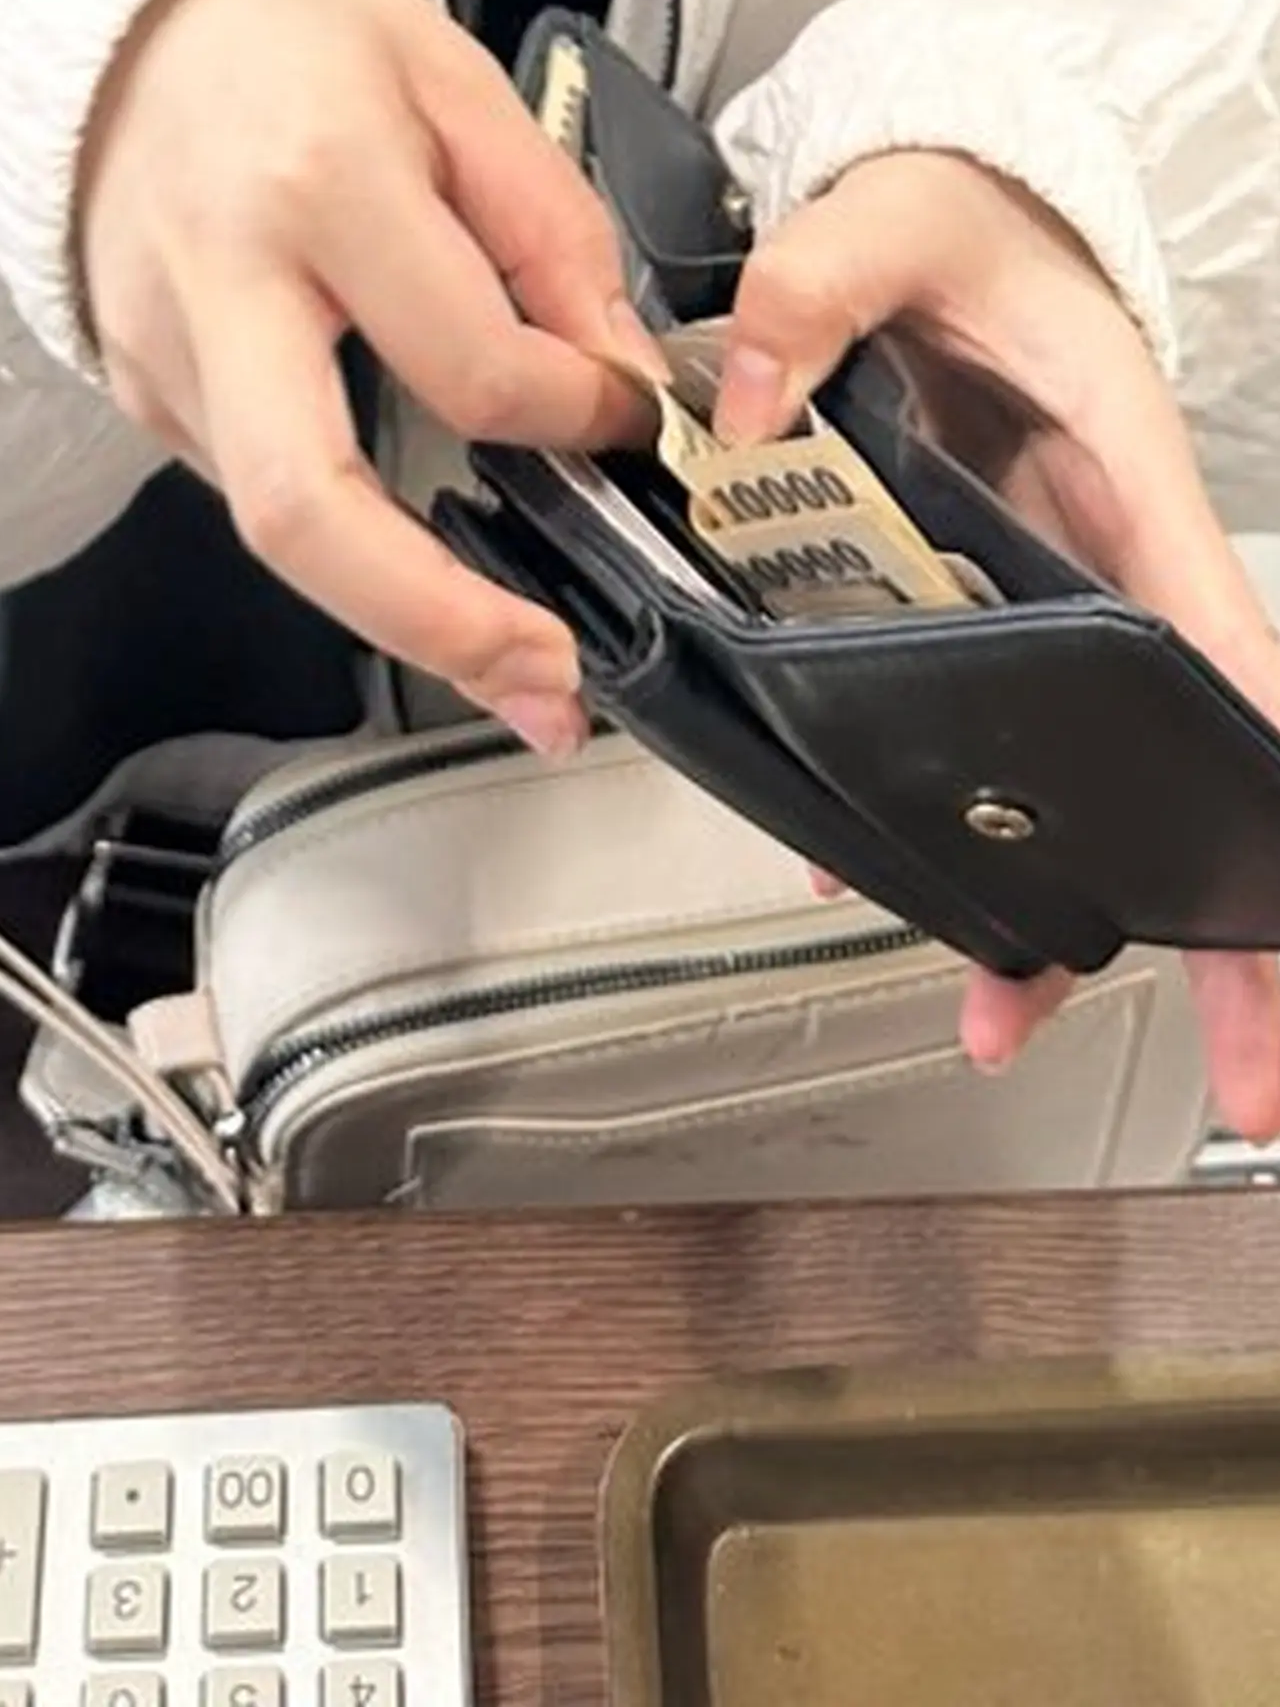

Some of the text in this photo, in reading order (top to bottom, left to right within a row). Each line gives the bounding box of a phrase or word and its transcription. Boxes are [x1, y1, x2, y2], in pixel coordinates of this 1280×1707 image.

[710, 466, 856, 523] 10000
[218, 1470, 276, 1508] 00
[345, 1465, 376, 1502] 0
[113, 1579, 143, 1621] 3
[229, 1574, 259, 1613] 2
[354, 1571, 372, 1607] 1
[348, 1674, 378, 1707] 4
